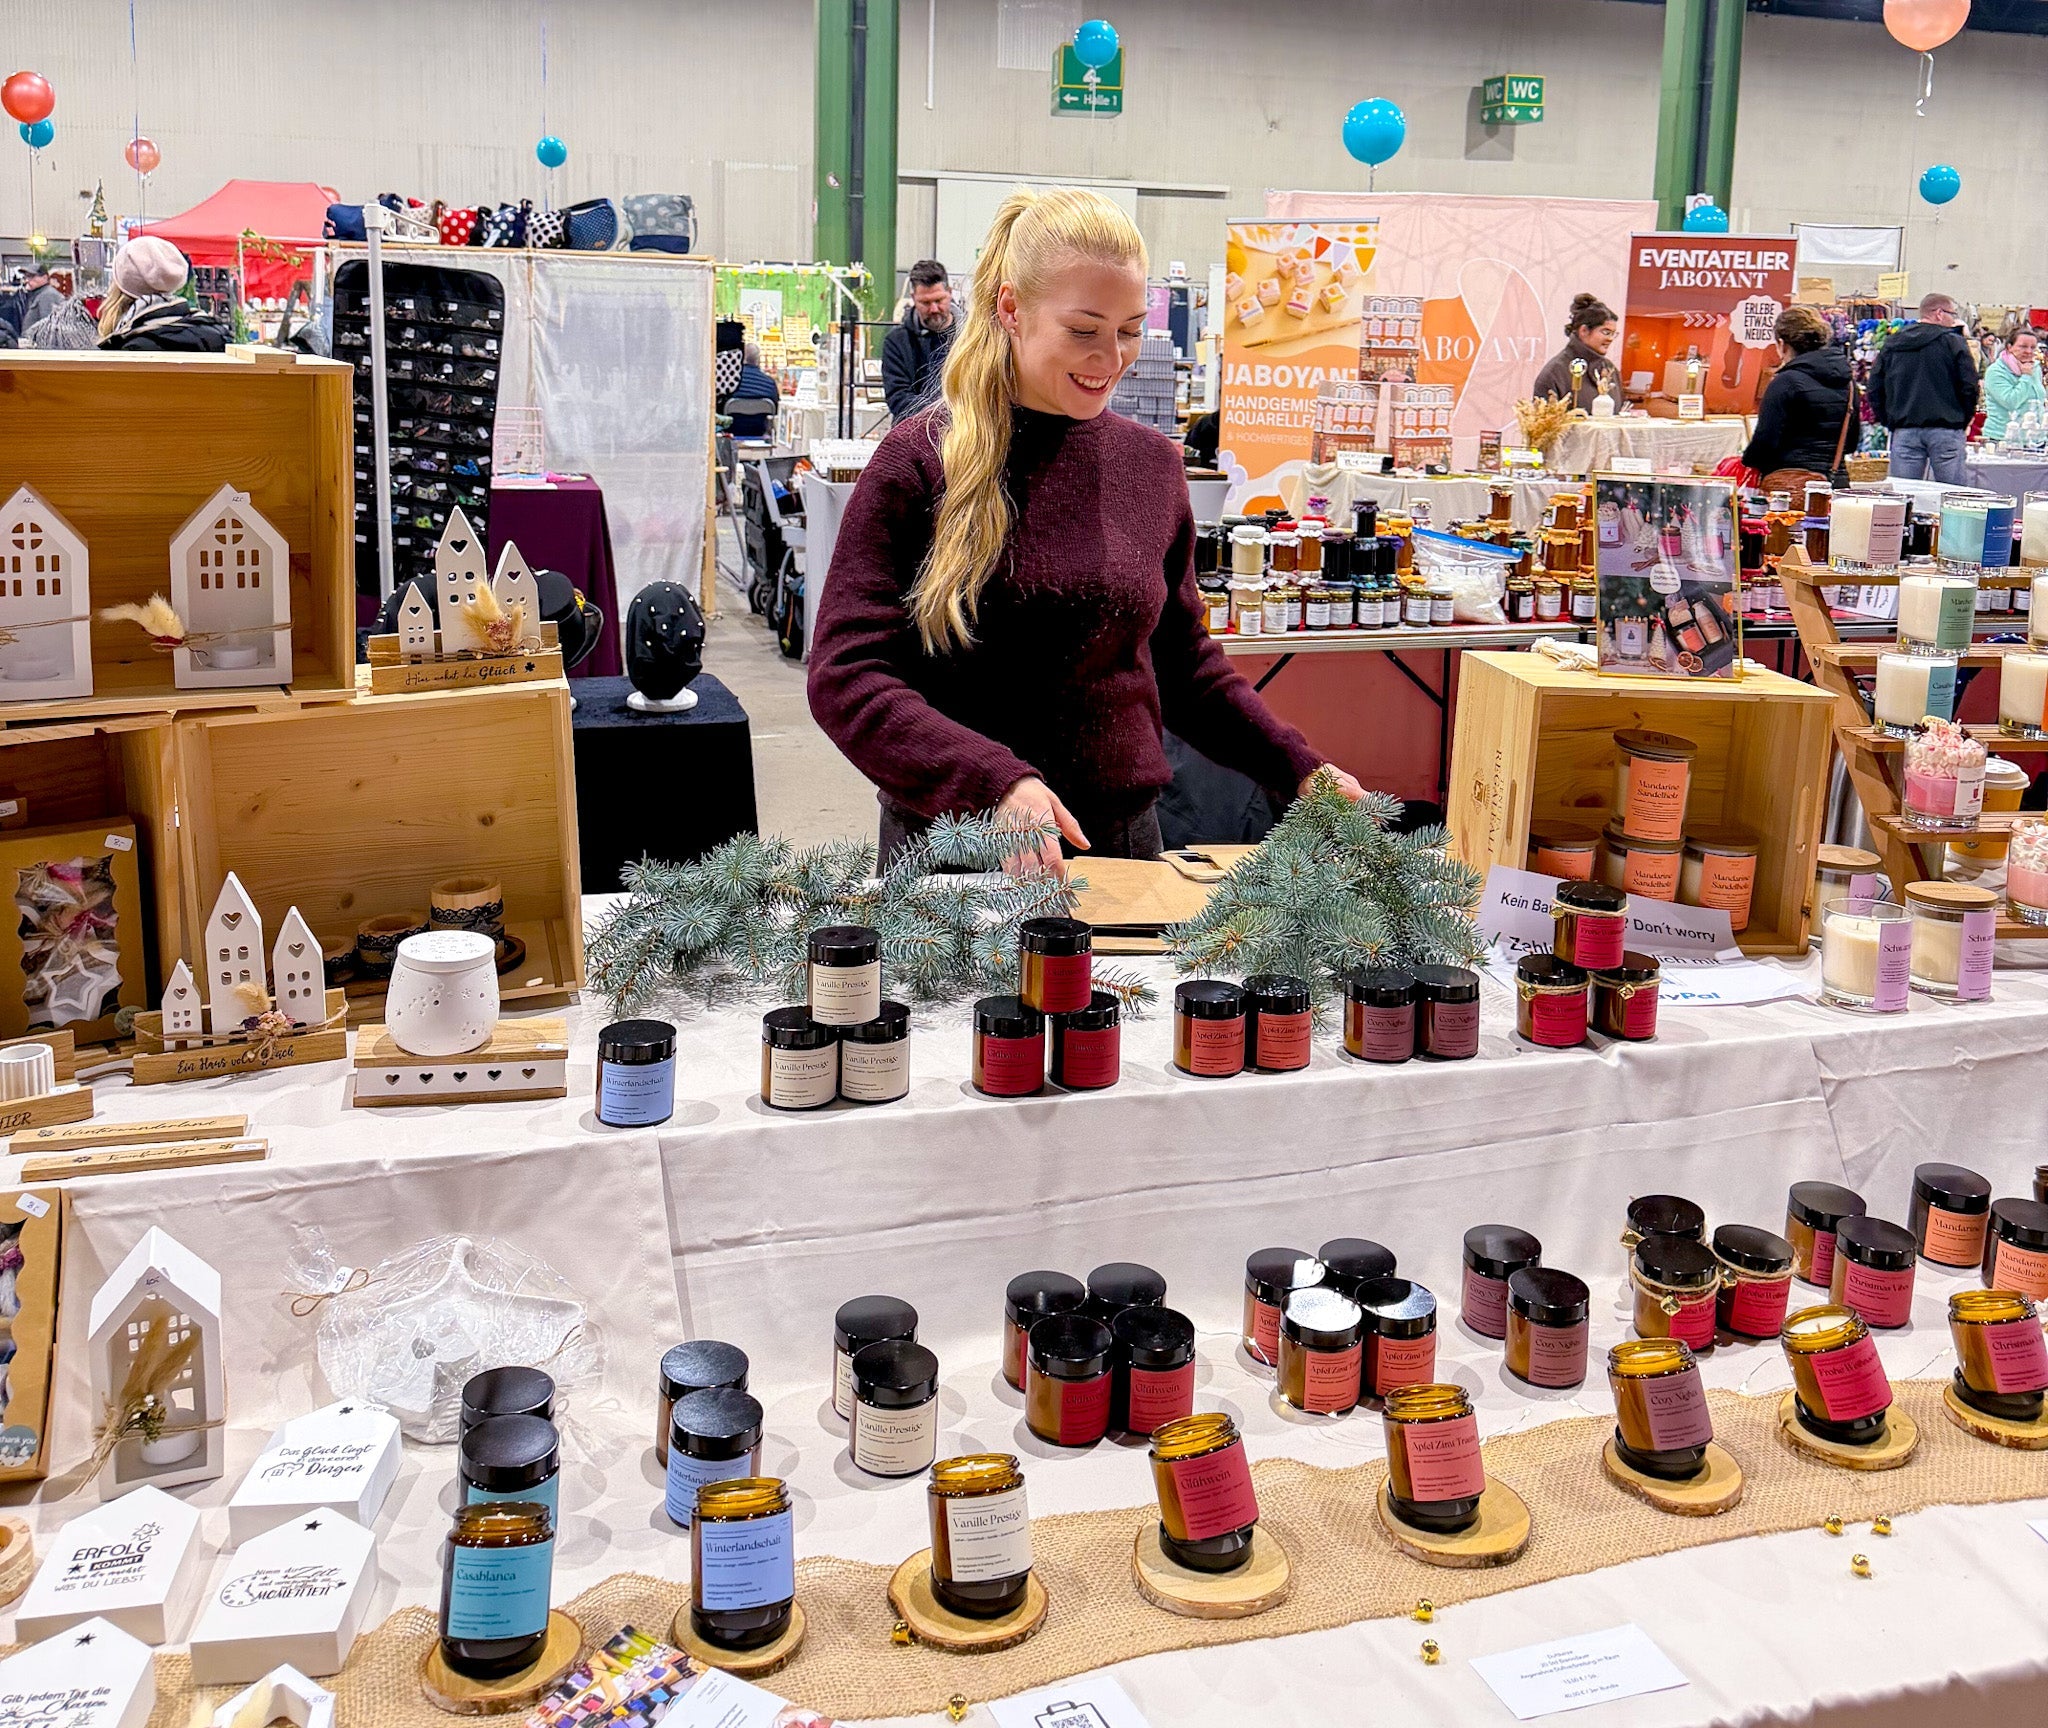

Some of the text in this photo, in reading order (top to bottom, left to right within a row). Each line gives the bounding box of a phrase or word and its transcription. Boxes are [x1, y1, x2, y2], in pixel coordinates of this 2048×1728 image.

[1485, 82, 1502, 102] WC
[1512, 81, 1539, 99] WC
[1112, 95, 1118, 106] 1
[1638, 248, 1790, 271] EVENTATELIER
[1659, 270, 1769, 290] JABOYANT
[1744, 302, 1775, 315] ERLEBE
[1744, 316, 1773, 328] ETWAS
[1745, 328, 1772, 341] NEUES
[479, 663, 518, 681] Glück
[1638, 779, 1680, 792] Mandarine
[1487, 750, 1502, 855] REGALEALI
[1636, 789, 1679, 801] Sandelholz
[1634, 869, 1673, 881] Mandarine
[1713, 874, 1750, 885] Mandarine
[1631, 878, 1672, 890] Sandelholz
[1500, 892, 1529, 909] Kein
[1675, 926, 1716, 943] worry
[816, 978, 841, 990] Vanille
[1657, 992, 1720, 1001] ayPal
[177, 1060, 195, 1075] Ein
[199, 1057, 227, 1072] Haus
[845, 1053, 869, 1064] Vanille
[775, 1061, 801, 1072] Vanille
[1935, 1217, 1980, 1233] Mandarine
[2001, 1249, 2047, 1269] Mandarine
[1999, 1260, 2047, 1279] Sandelholz
[1849, 1274, 1892, 1292] Christmas
[1535, 1338, 1556, 1350] Cozy
[1383, 1351, 1404, 1363] Apfel
[1311, 1364, 1332, 1376] Apfel
[1134, 1382, 1181, 1394] Glühwein
[1650, 1392, 1674, 1406] Cozy
[859, 1417, 923, 1434] Vanille Prestige
[20, 1437, 37, 1448] you
[1412, 1440, 1434, 1453] Apfel
[1434, 1437, 1456, 1449] Zimt
[279, 1448, 300, 1457] Das
[305, 1462, 364, 1478] Dingen
[1181, 1469, 1232, 1491] Glühwein
[953, 1509, 1022, 1529] Vanille Prestige
[72, 1540, 152, 1562] ERFOLG
[705, 1536, 781, 1553] Winterlandschaft
[93, 1556, 142, 1571] KOMMT
[455, 1567, 518, 1582] Casablanca
[55, 1574, 145, 1592] WAS DU LIEBST
[252, 1586, 331, 1601] MOMENTEN
[1, 1686, 111, 1705] Gib jedem Tag die
